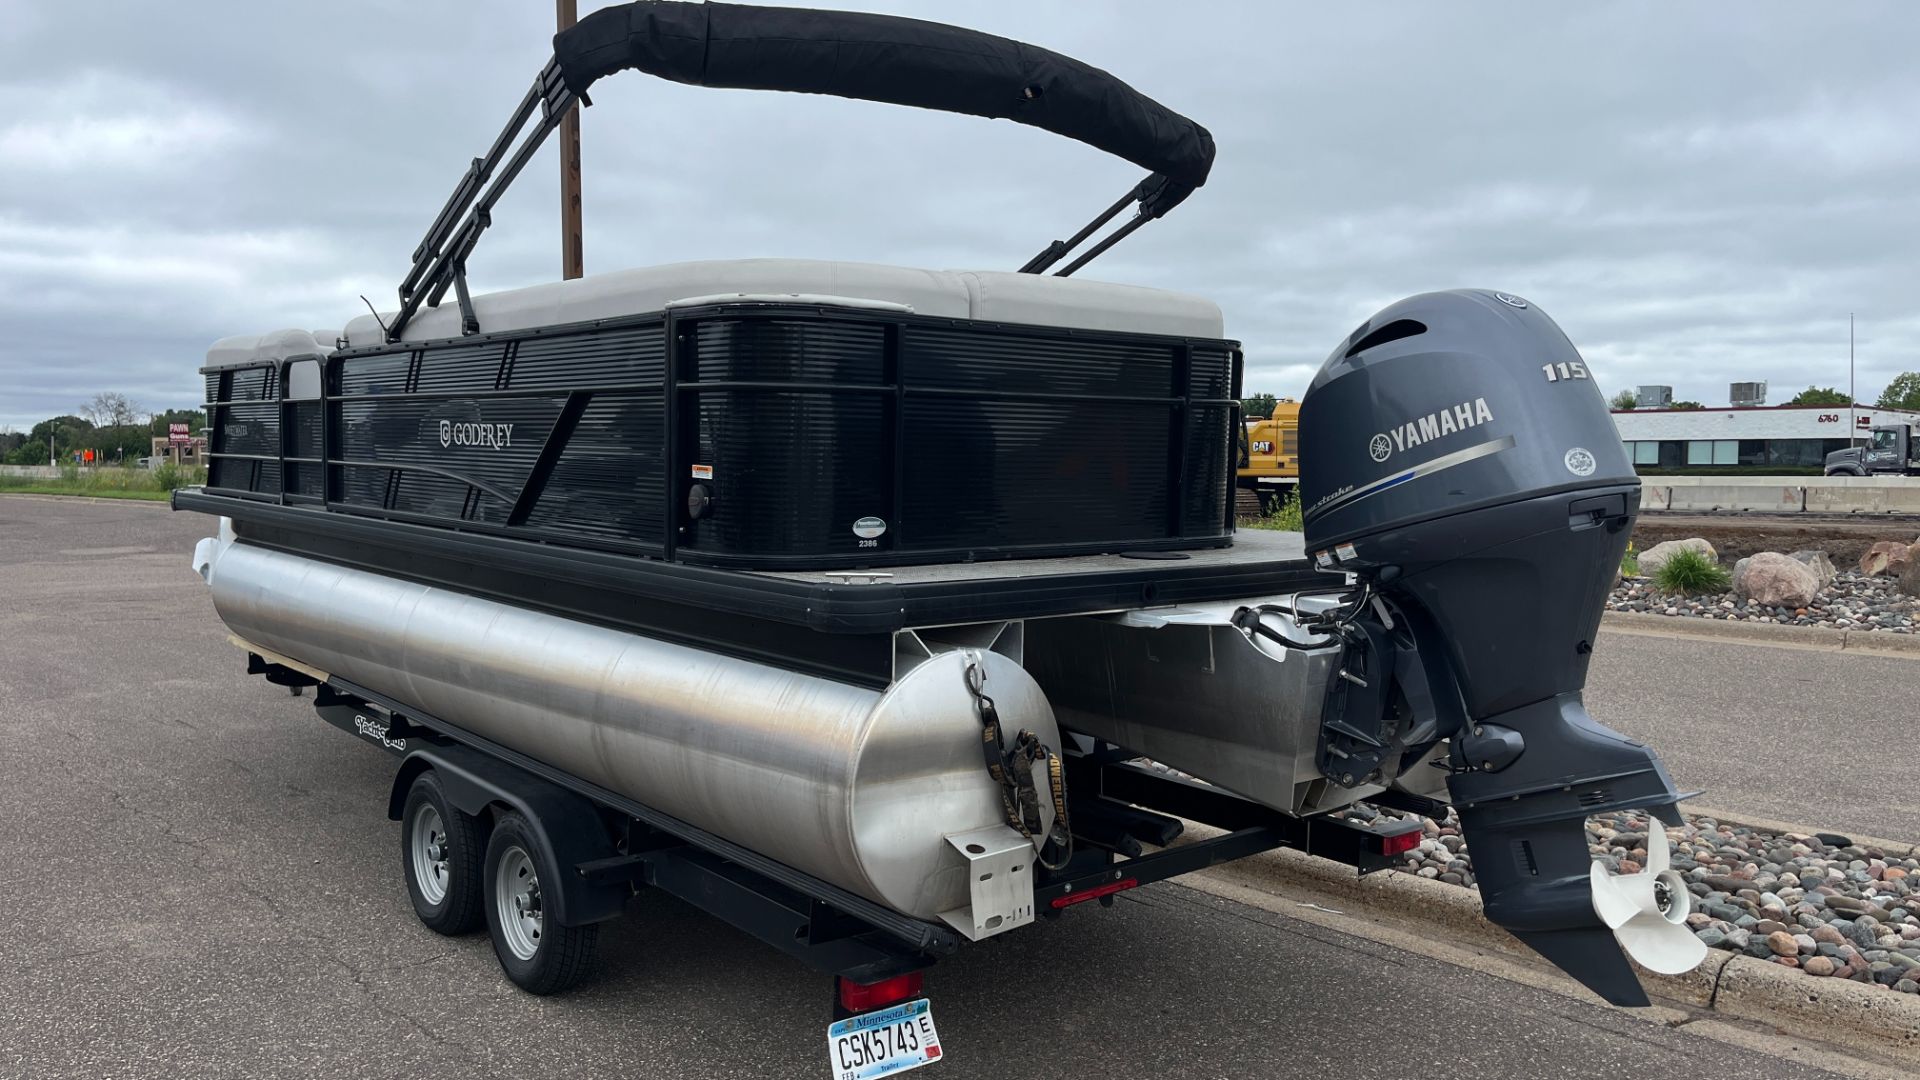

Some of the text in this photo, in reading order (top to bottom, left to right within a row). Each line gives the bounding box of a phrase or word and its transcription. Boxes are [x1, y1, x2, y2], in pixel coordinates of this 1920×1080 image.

[1542, 361, 1588, 382] 115
[169, 423, 189, 433] PAWN
[1390, 397, 1495, 452] YAMAHA
[1818, 414, 1839, 423] 6760
[454, 422, 514, 451] GODFREY
[1252, 441, 1271, 452] CAT
[857, 1009, 903, 1028] Minnesota
[838, 1016, 931, 1070] CSK5743 E
[881, 1062, 900, 1072] Trailer
